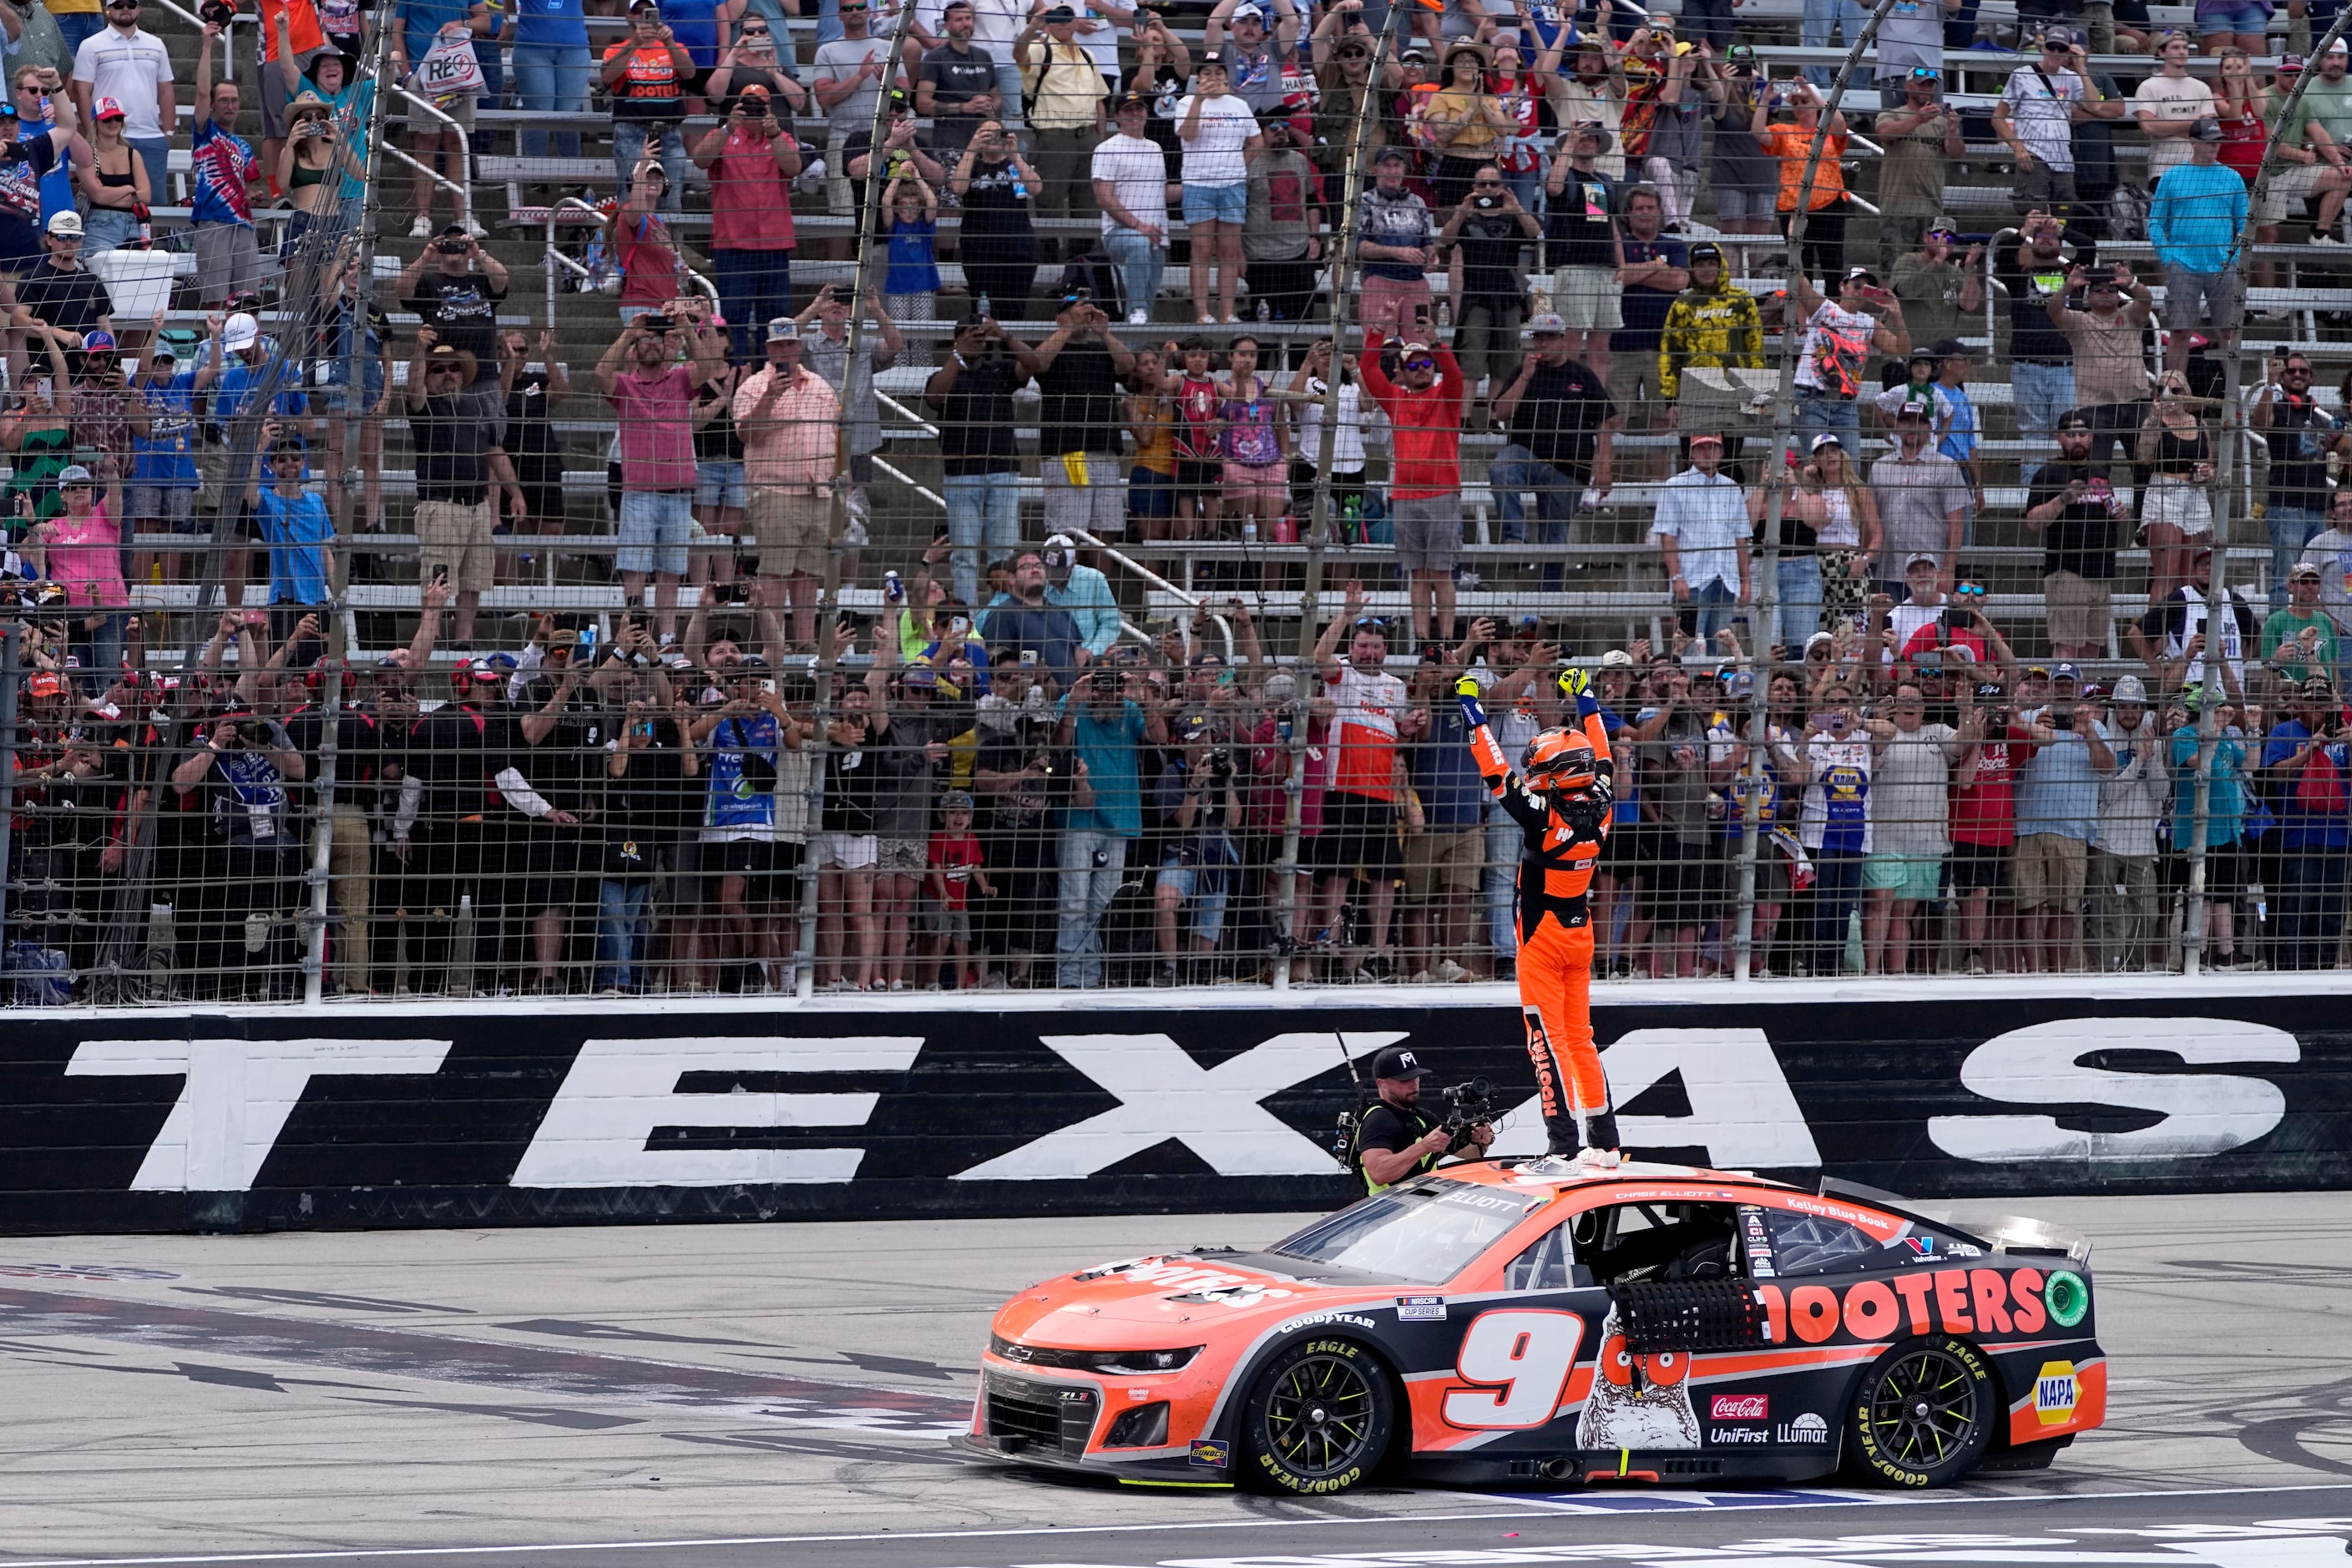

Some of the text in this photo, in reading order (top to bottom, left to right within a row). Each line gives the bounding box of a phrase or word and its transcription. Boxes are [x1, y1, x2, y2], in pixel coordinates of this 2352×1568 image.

[959, 66, 987, 75] Columbia
[2171, 105, 2197, 114] MONEY
[18, 159, 30, 180] 5
[1695, 307, 1733, 320] HUSTLE
[1482, 725, 1505, 766] OOTERS
[1994, 743, 2009, 757] 14
[841, 751, 863, 771] 9
[1834, 773, 1857, 784] NAPA
[1532, 1029, 1558, 1118] HOOTERS
[64, 1013, 2303, 1195] TEXAS
[1449, 1191, 1521, 1212] ELLIOTT
[1660, 1191, 1714, 1200] ELLIOTT
[1786, 1197, 1889, 1229] Kelley Blue Book
[1911, 1254, 1943, 1264] Valvoline
[1411, 1297, 1438, 1306] NASCAR
[1404, 1308, 1419, 1316] CUP
[1279, 1312, 1377, 1334] GOODYEAR
[1305, 1339, 1359, 1359] EAGLE
[1443, 1308, 1586, 1433] 9
[1945, 1339, 1987, 1382] EAGLE
[1059, 1391, 1089, 1402] ZL1
[2039, 1378, 2073, 1408] NAPA
[1712, 1397, 1767, 1419] Coca-Cola
[1710, 1427, 1769, 1444] UniFirst
[1777, 1423, 1828, 1444] LLumar
[1192, 1449, 1226, 1458] SUNOCO
[1857, 1406, 1929, 1486] GOODYEAR
[1259, 1452, 1362, 1494] GOODYEAR
